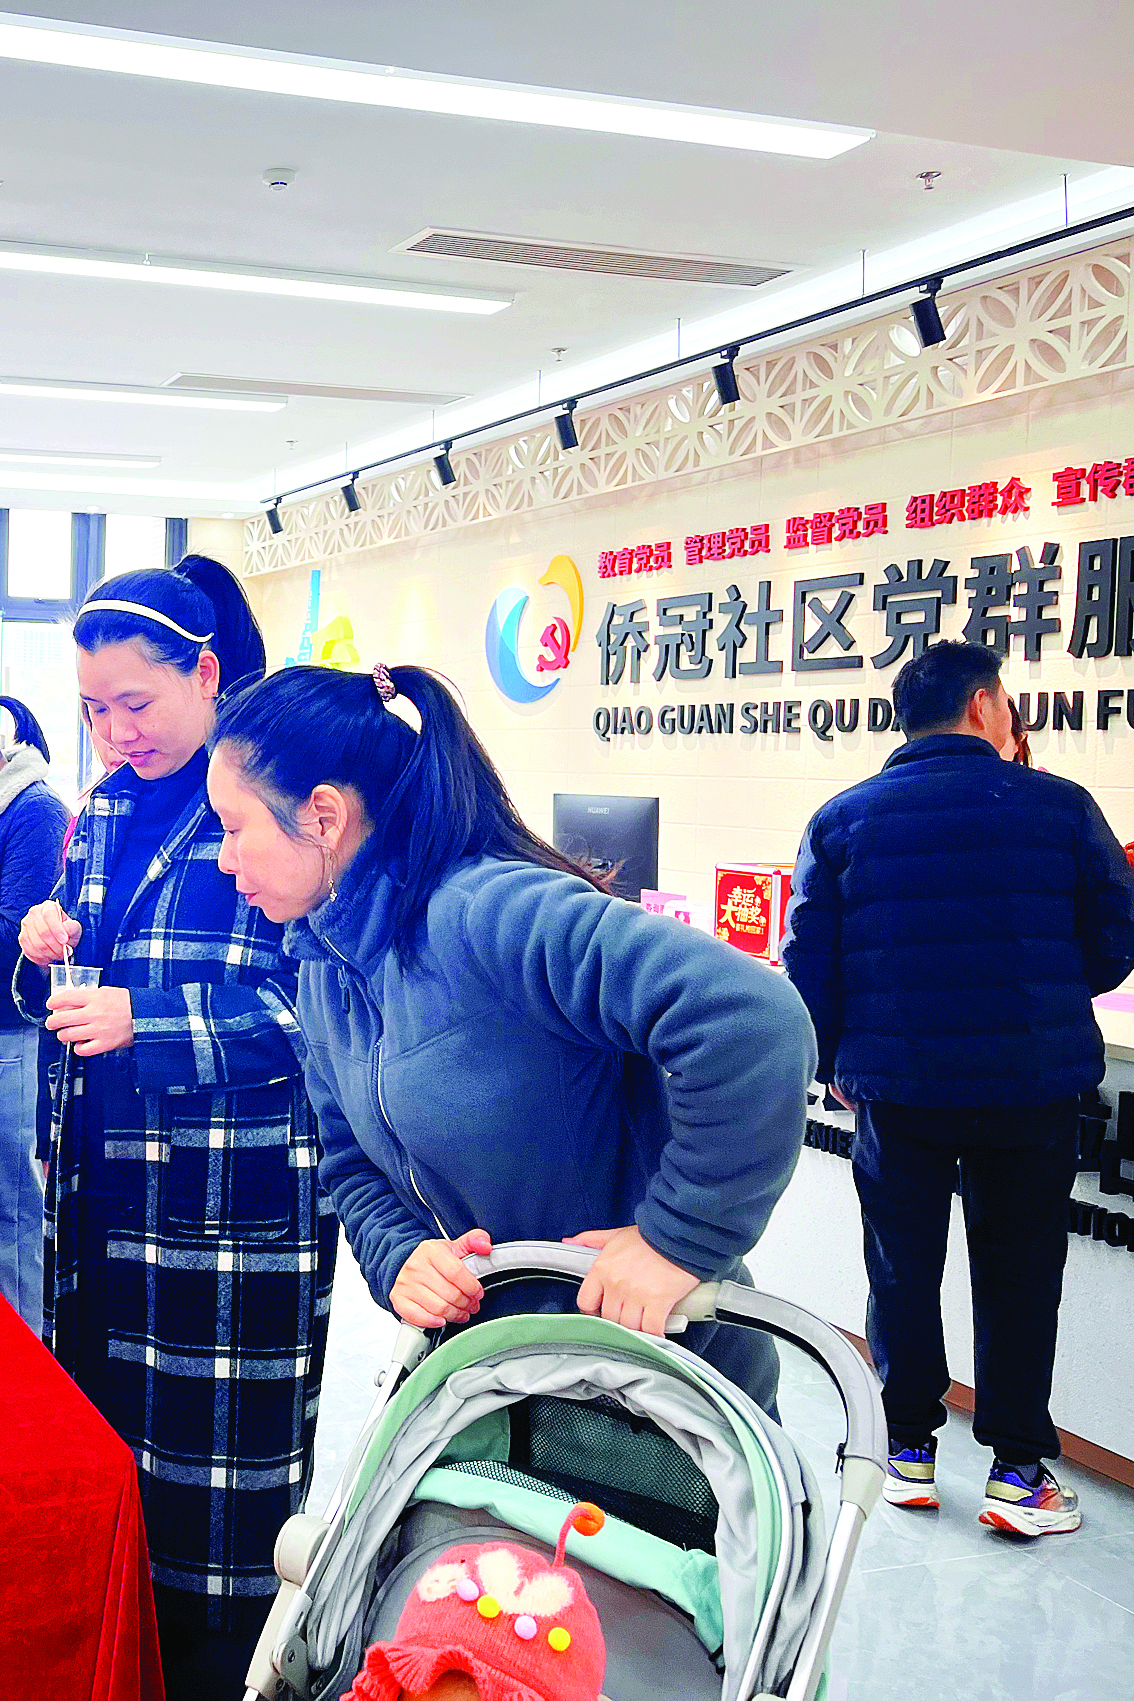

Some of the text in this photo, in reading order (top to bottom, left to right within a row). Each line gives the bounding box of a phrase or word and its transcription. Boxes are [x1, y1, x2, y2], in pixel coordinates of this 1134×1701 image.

[597, 541, 673, 578] 教育党员
[684, 523, 771, 565] 管理党员
[784, 502, 888, 549] 监督党员
[905, 476, 1032, 529] 组织群众
[593, 705, 653, 742] QIAO
[657, 703, 735, 735] GUAN
[739, 700, 802, 734] SHE
[807, 698, 860, 742] QU
[1096, 689, 1134, 731] F
[587, 806, 610, 815] HUAWEI
[727, 885, 757, 906] 幸运
[718, 898, 762, 929] 大抽奖
